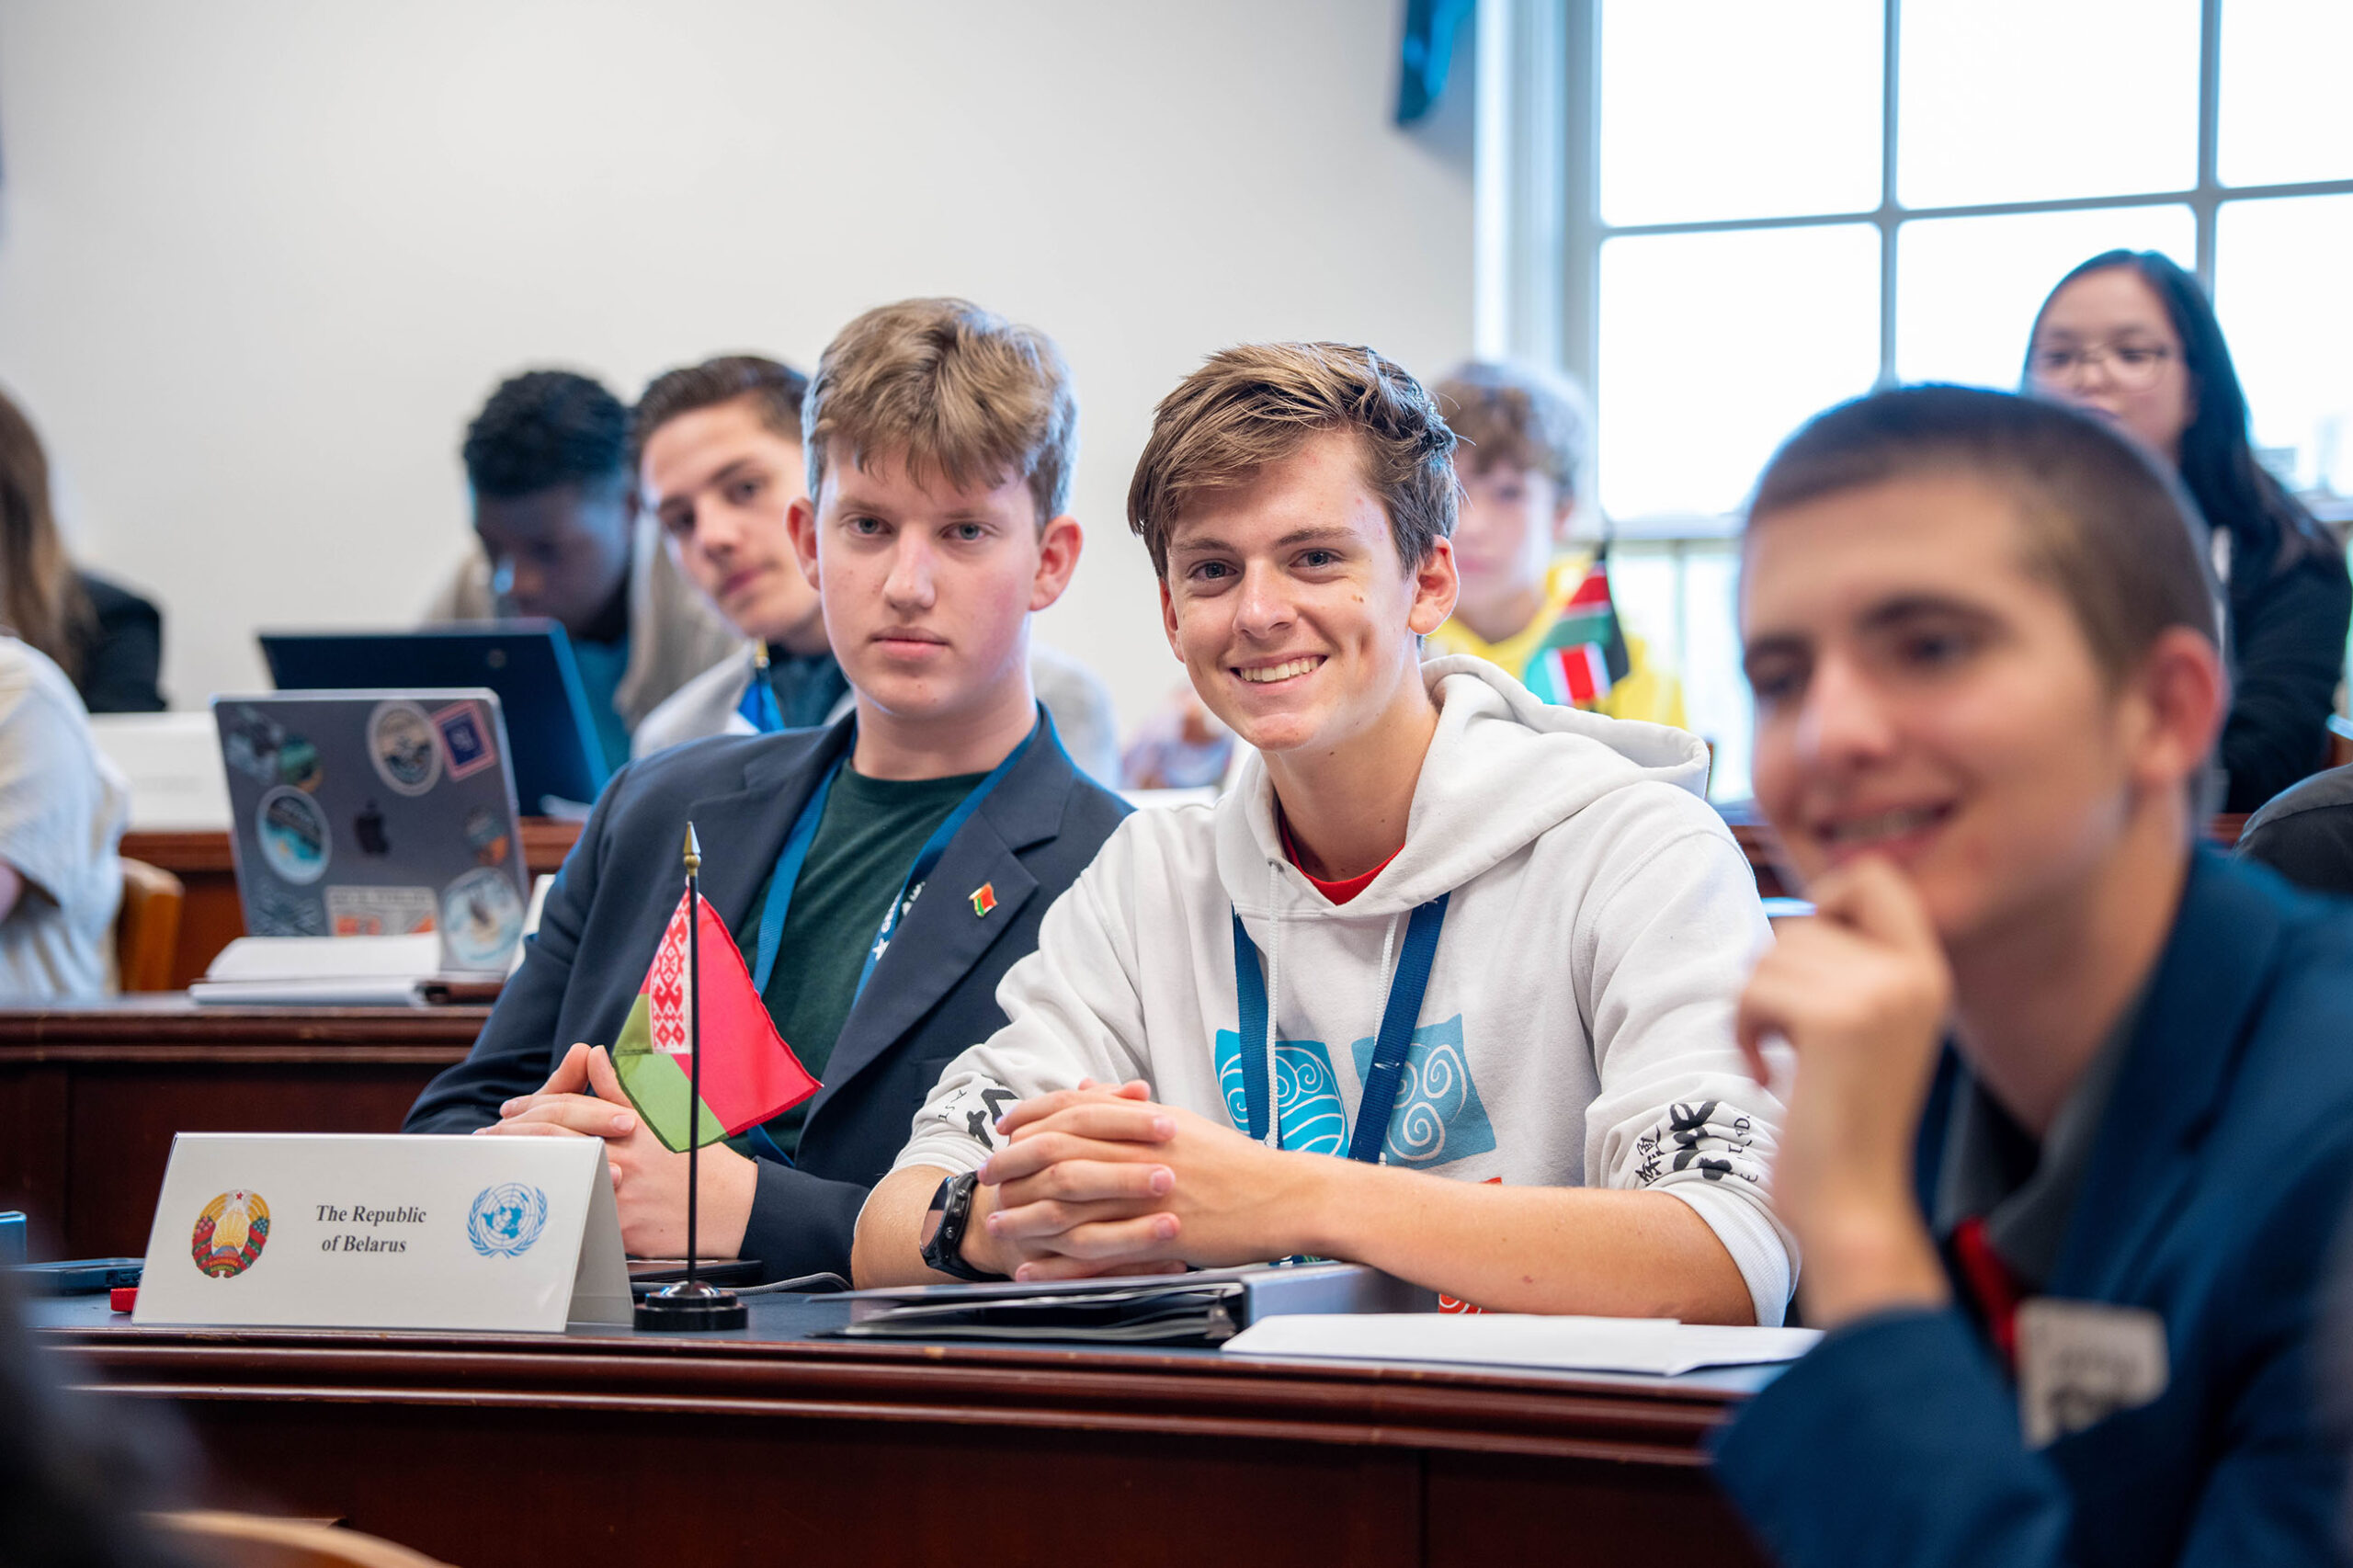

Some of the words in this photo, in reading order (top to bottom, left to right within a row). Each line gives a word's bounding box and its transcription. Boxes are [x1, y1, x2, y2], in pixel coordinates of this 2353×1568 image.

[316, 1204, 347, 1221] The
[351, 1205, 427, 1226] Republic
[321, 1234, 341, 1252] of
[342, 1234, 407, 1253] Belarus
